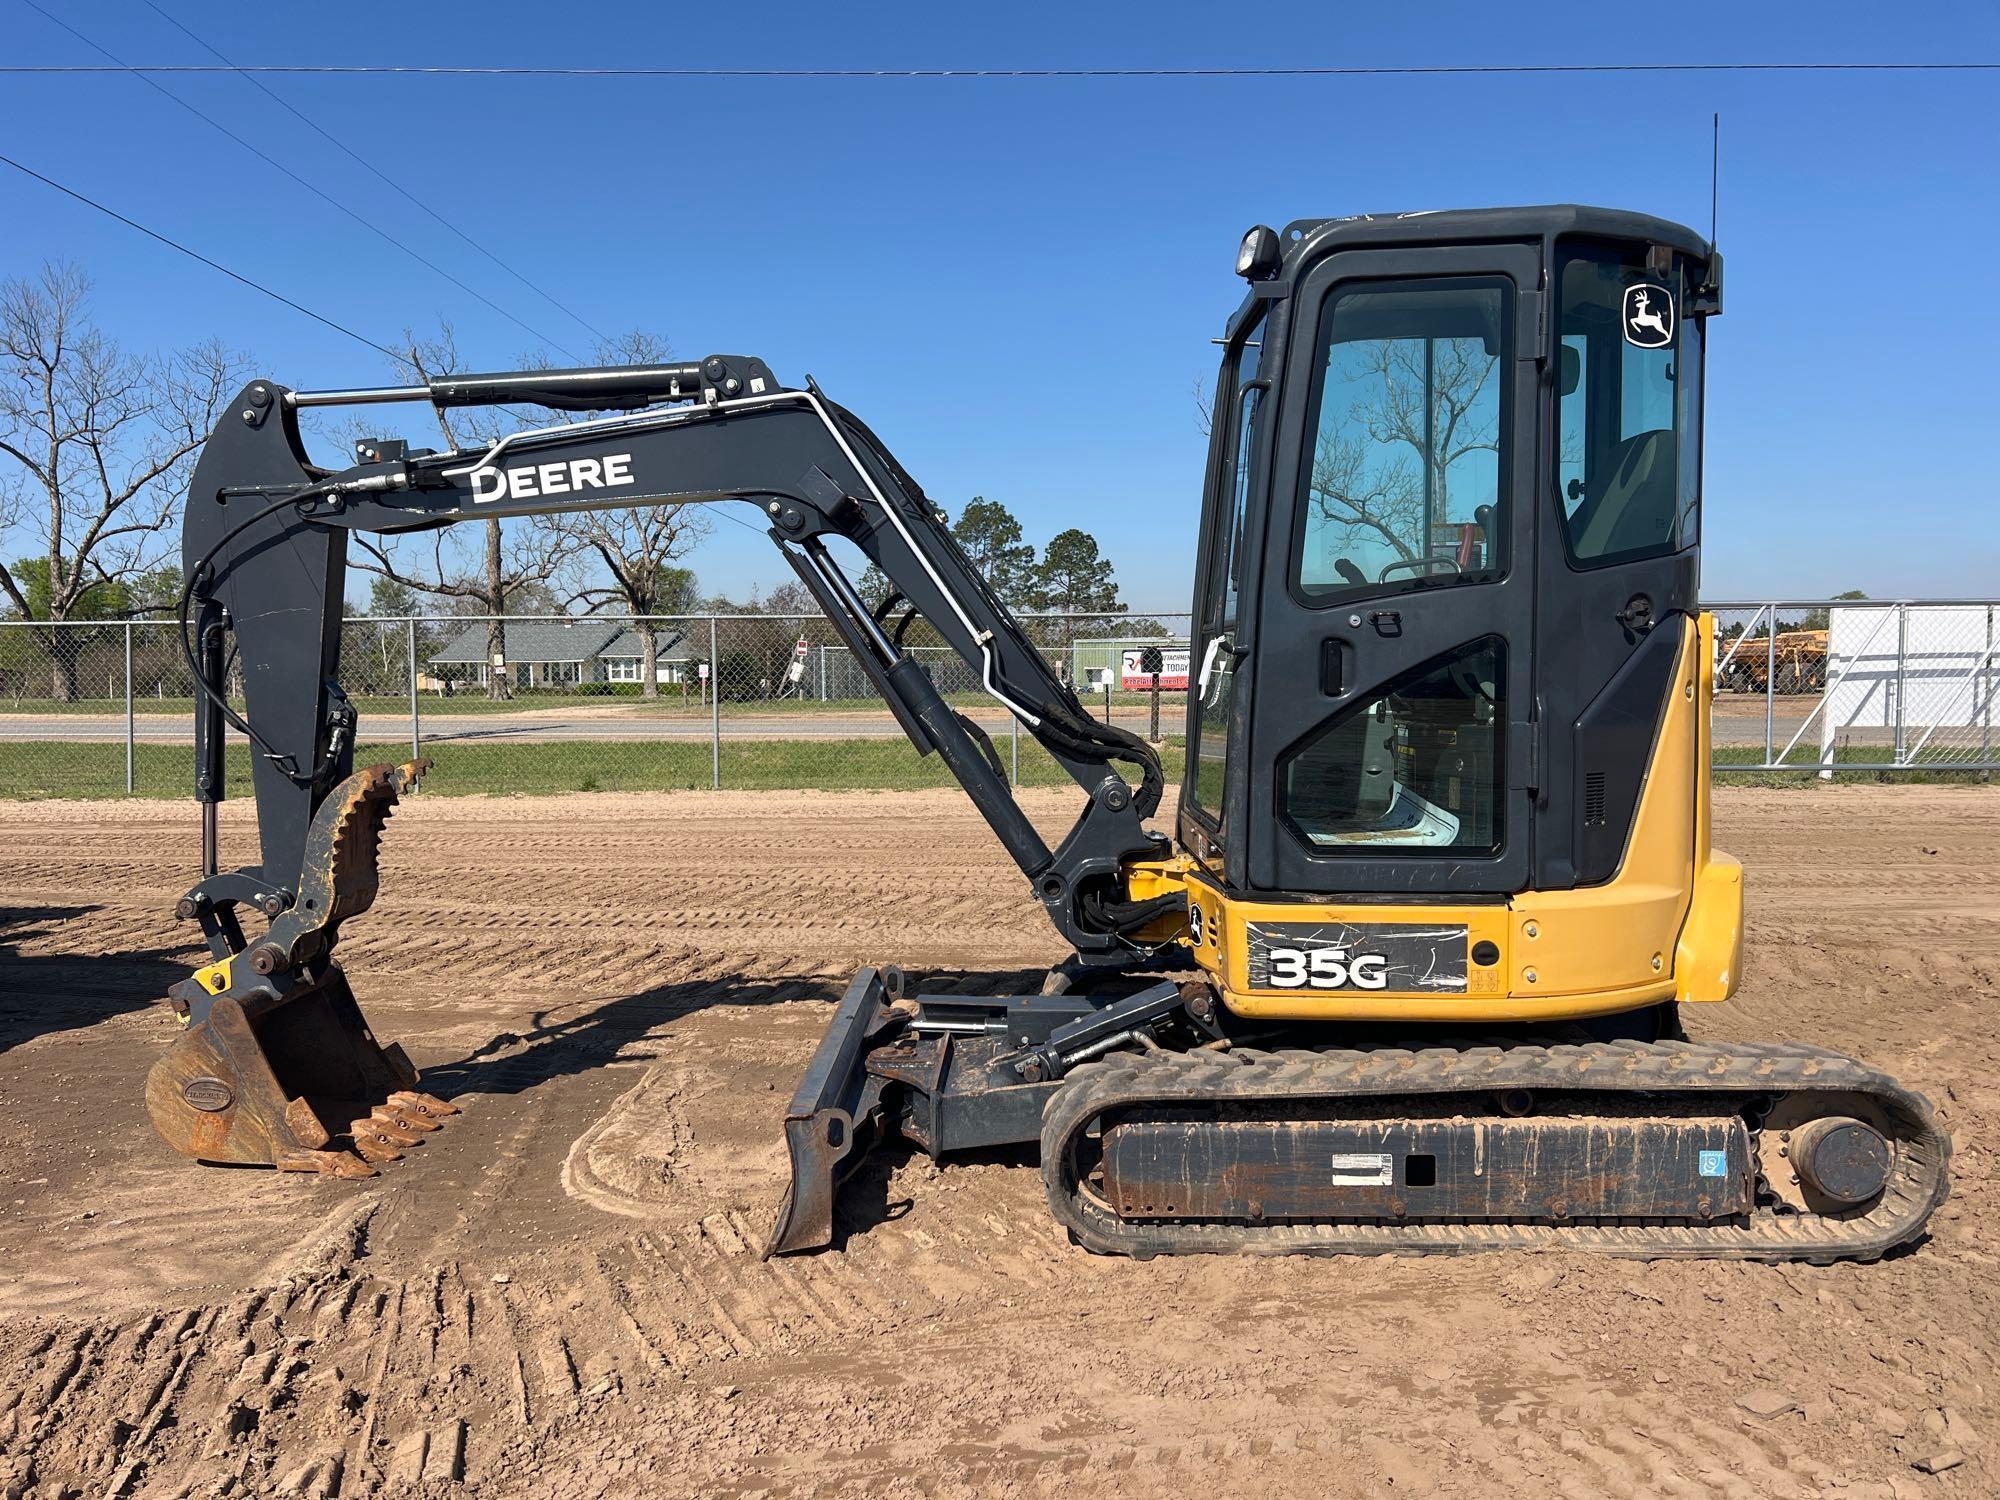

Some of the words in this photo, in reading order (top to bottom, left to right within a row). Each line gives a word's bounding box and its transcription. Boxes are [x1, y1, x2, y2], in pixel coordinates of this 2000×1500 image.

[470, 453, 635, 504] DEERE
[1166, 663, 1189, 672] TODAY
[1270, 949, 1387, 989] 35G
